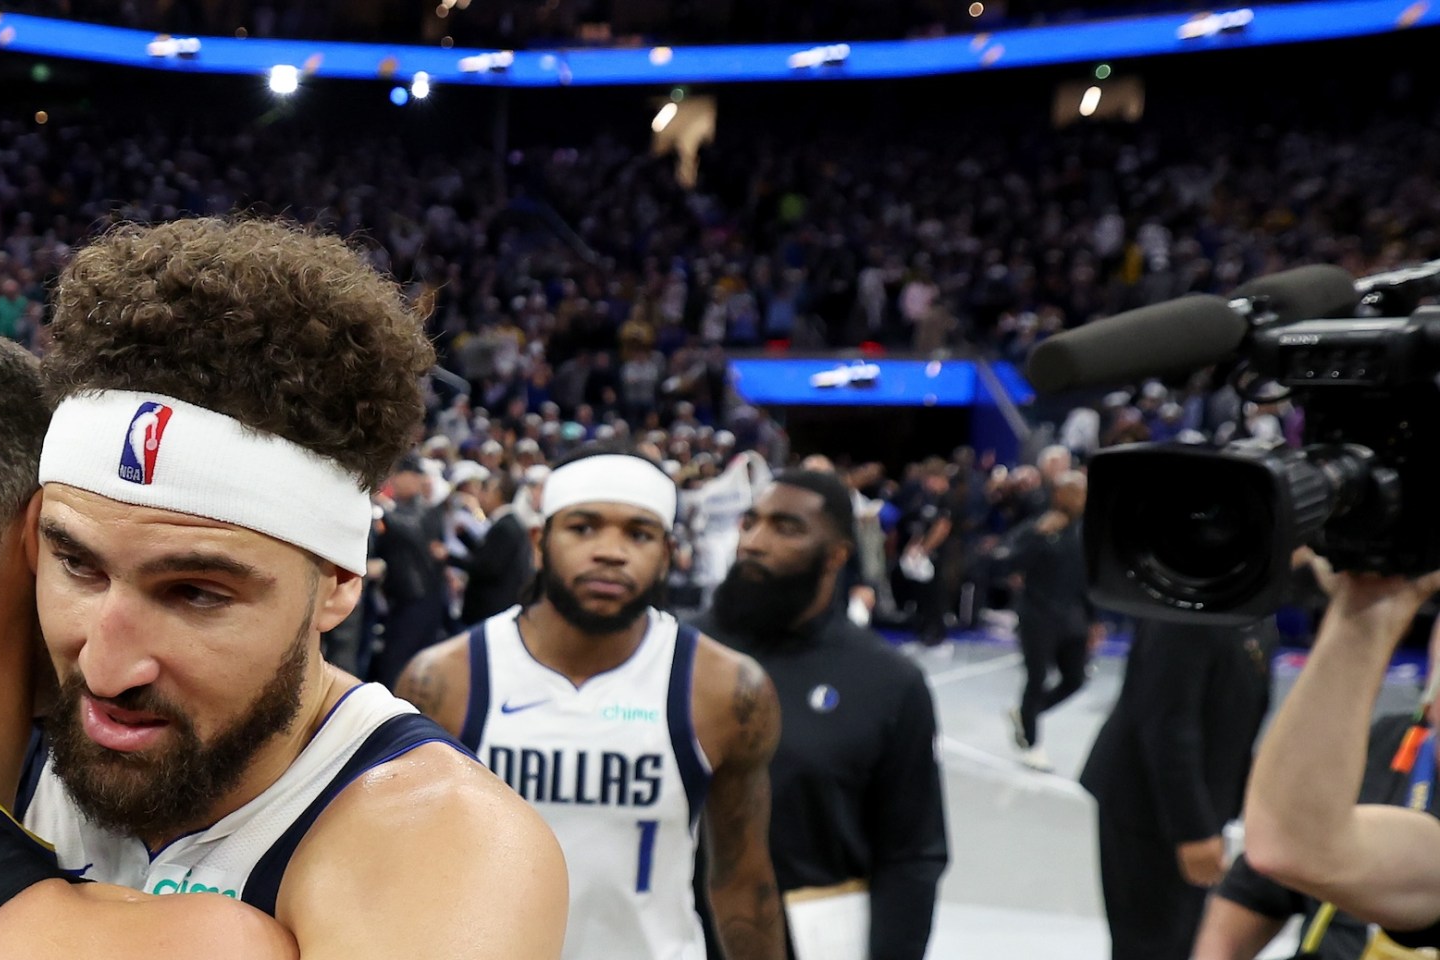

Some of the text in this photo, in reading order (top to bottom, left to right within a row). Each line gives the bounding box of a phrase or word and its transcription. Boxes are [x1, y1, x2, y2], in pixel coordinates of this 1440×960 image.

[120, 464, 140, 481] NBA
[602, 705, 658, 722] chime
[489, 746, 663, 807] DALLAS
[635, 820, 659, 893] 1
